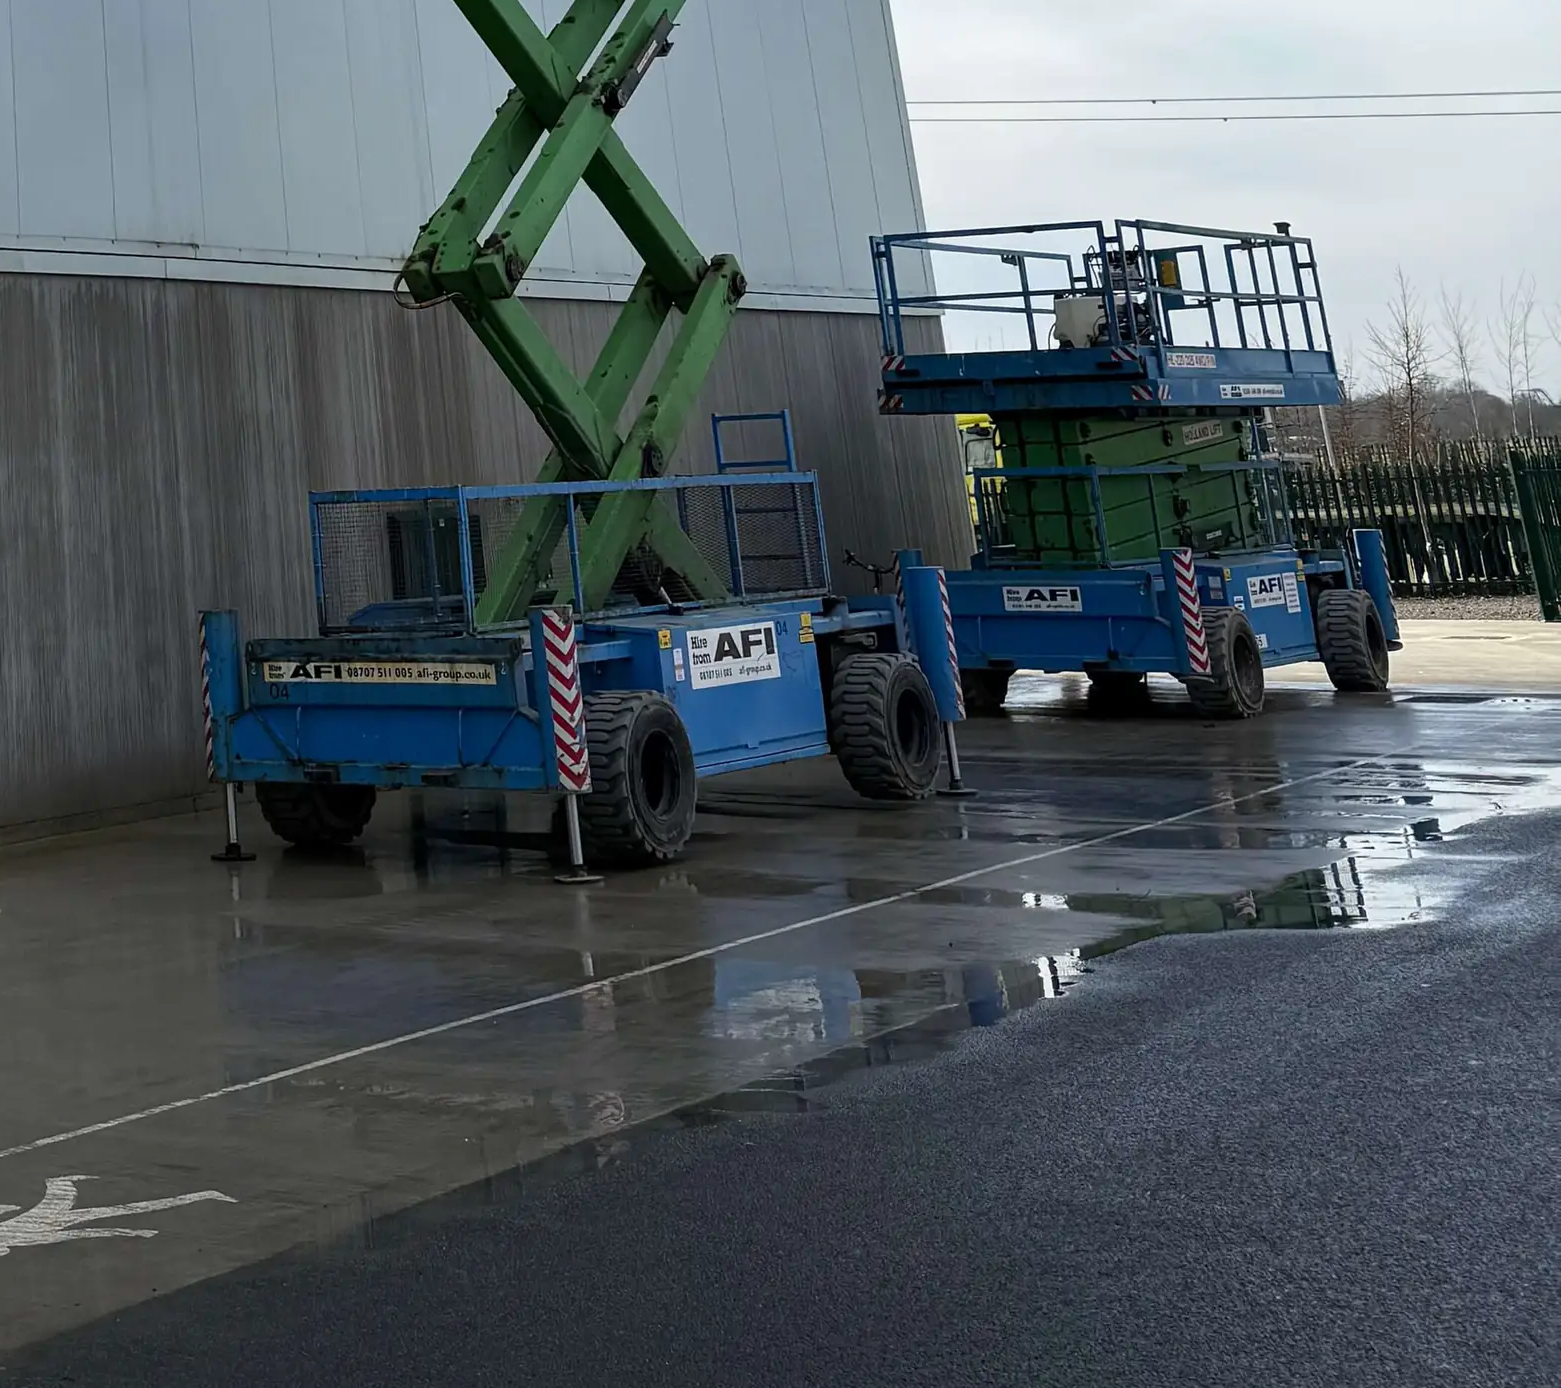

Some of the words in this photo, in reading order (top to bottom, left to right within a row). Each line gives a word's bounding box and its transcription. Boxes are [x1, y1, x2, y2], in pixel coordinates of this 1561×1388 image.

[1258, 576, 1282, 594] AFI
[1024, 588, 1080, 601] AFI
[775, 620, 788, 636] 04
[690, 636, 708, 649] Hire
[713, 626, 776, 662] AFI
[692, 651, 712, 665] from
[290, 664, 343, 679] AFI
[347, 667, 375, 678] 08707
[377, 667, 392, 678] 511
[395, 667, 413, 678] 005
[416, 668, 491, 682] afi-group.co.uk
[269, 683, 290, 700] 04
